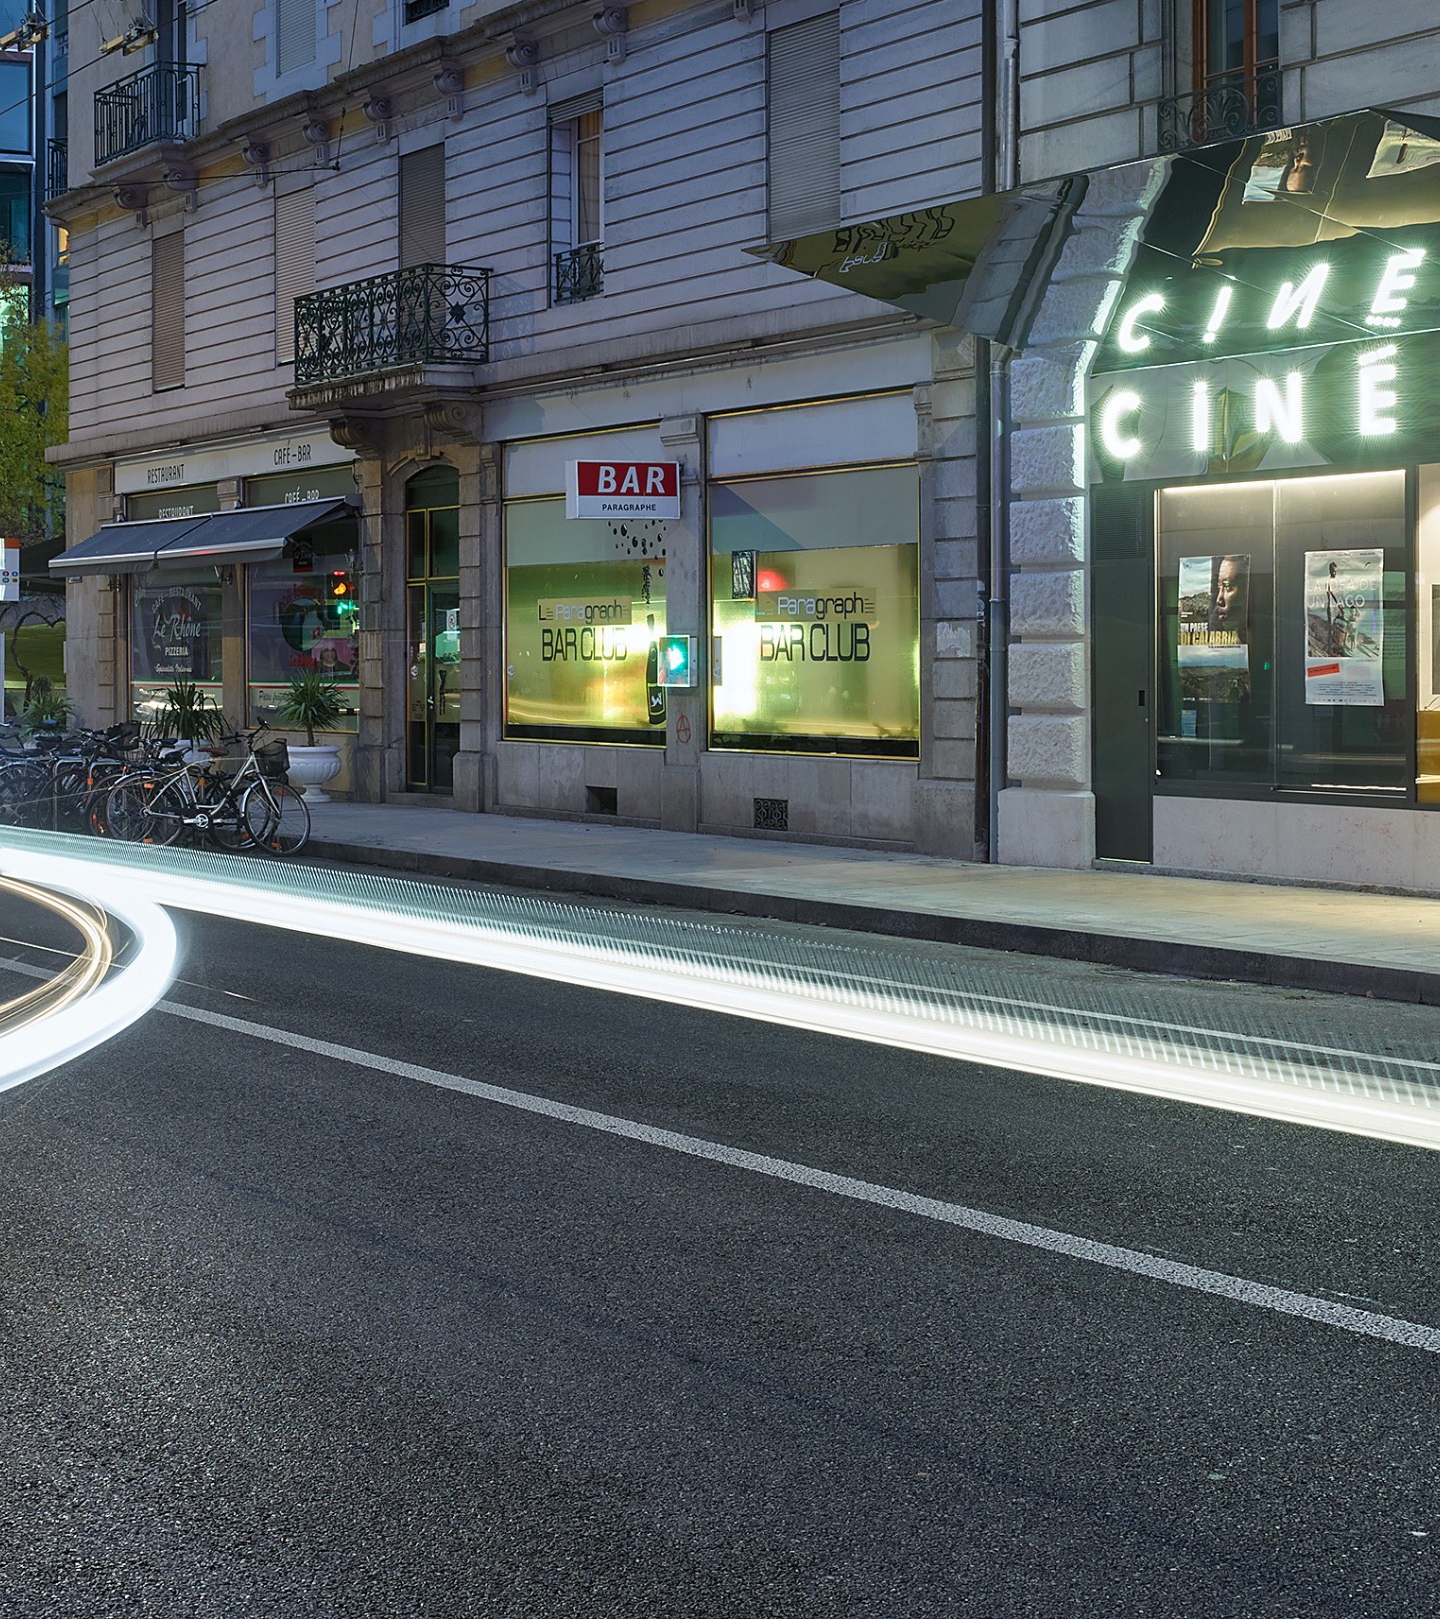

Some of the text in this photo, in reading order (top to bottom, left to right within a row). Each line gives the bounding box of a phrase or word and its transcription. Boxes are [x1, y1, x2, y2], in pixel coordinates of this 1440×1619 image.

[147, 464, 185, 484] RESTAURANT
[597, 465, 666, 494] BAR
[602, 503, 657, 512] PARAGRAPHE
[542, 627, 627, 661] BAR CLUB
[760, 623, 871, 662] BAR CLUB
[1180, 631, 1237, 646] DI CALABRIA
[164, 646, 189, 656] PIZZERIA
